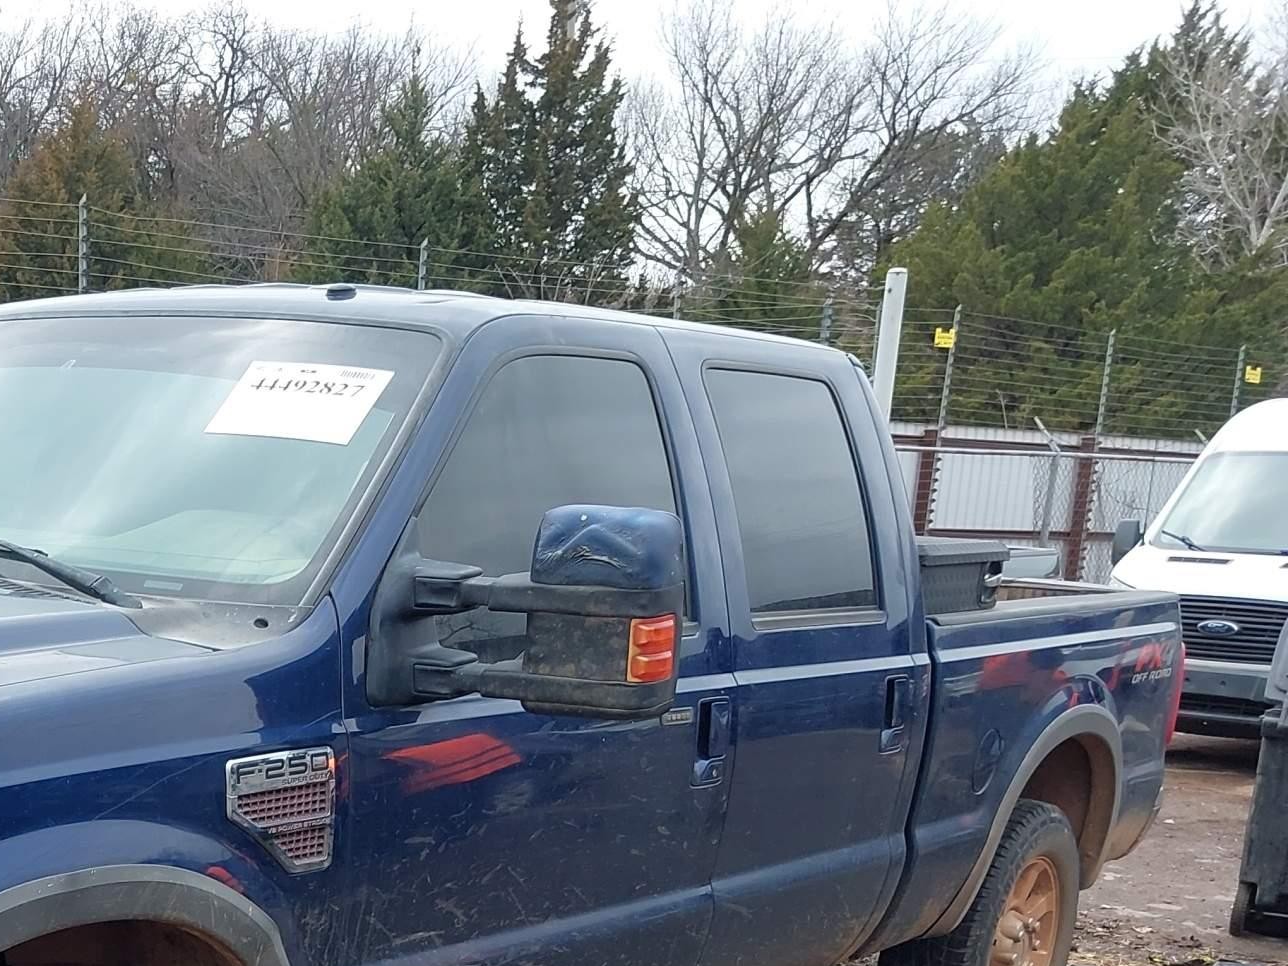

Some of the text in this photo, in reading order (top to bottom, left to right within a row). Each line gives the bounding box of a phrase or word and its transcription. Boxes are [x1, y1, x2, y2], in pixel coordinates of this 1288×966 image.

[251, 377, 366, 397] 44492827
[1131, 671, 1149, 685] OFF
[235, 751, 330, 785] F-250
[282, 769, 332, 786] SUPER DUTY
